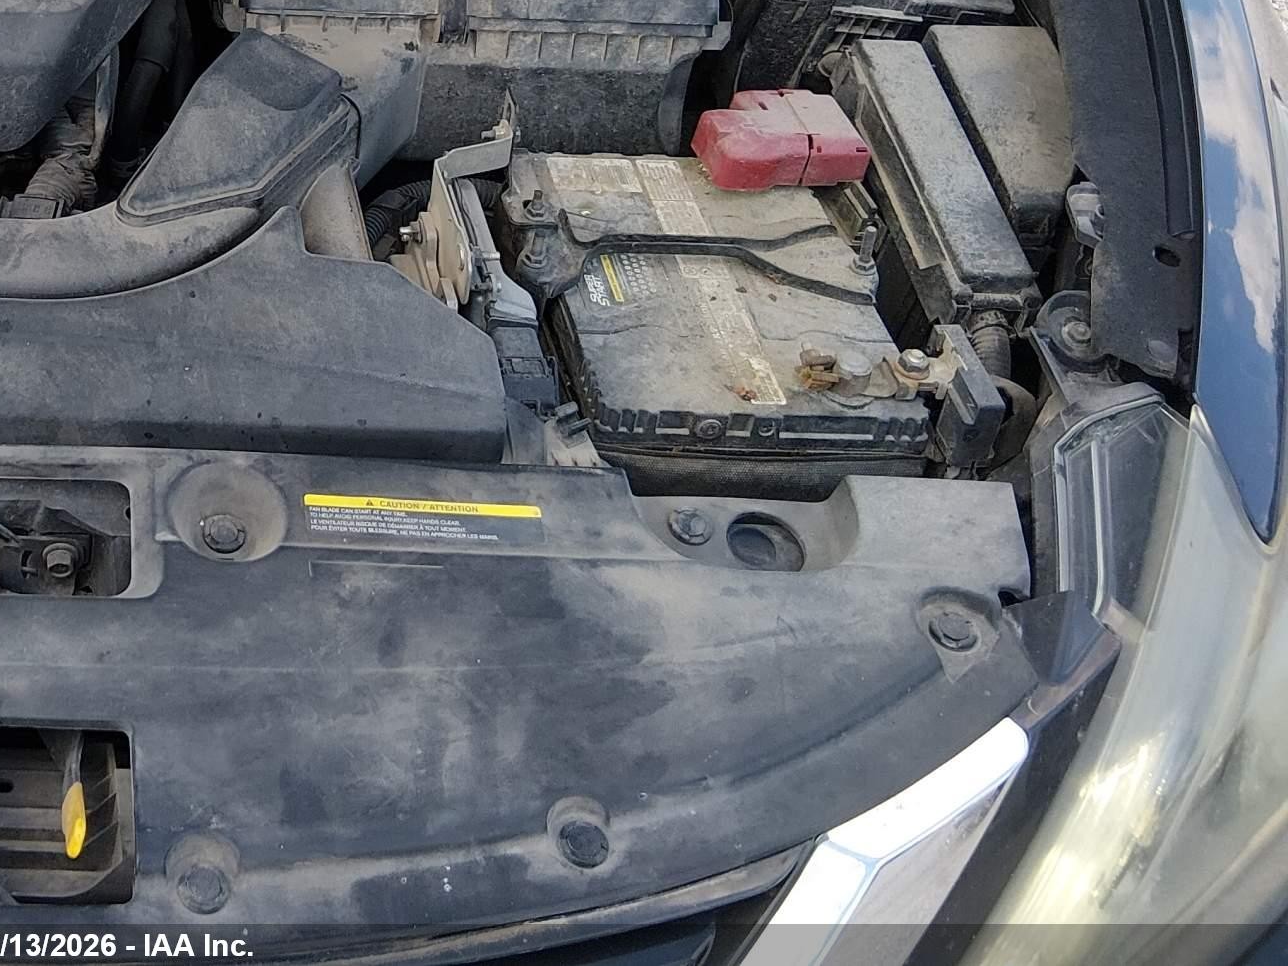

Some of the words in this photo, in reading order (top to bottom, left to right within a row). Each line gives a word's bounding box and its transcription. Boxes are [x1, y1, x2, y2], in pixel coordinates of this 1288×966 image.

[583, 273, 597, 303] SUPER
[592, 274, 610, 307] START
[380, 500, 419, 510] CAUTION
[429, 503, 479, 513] ATTENTION
